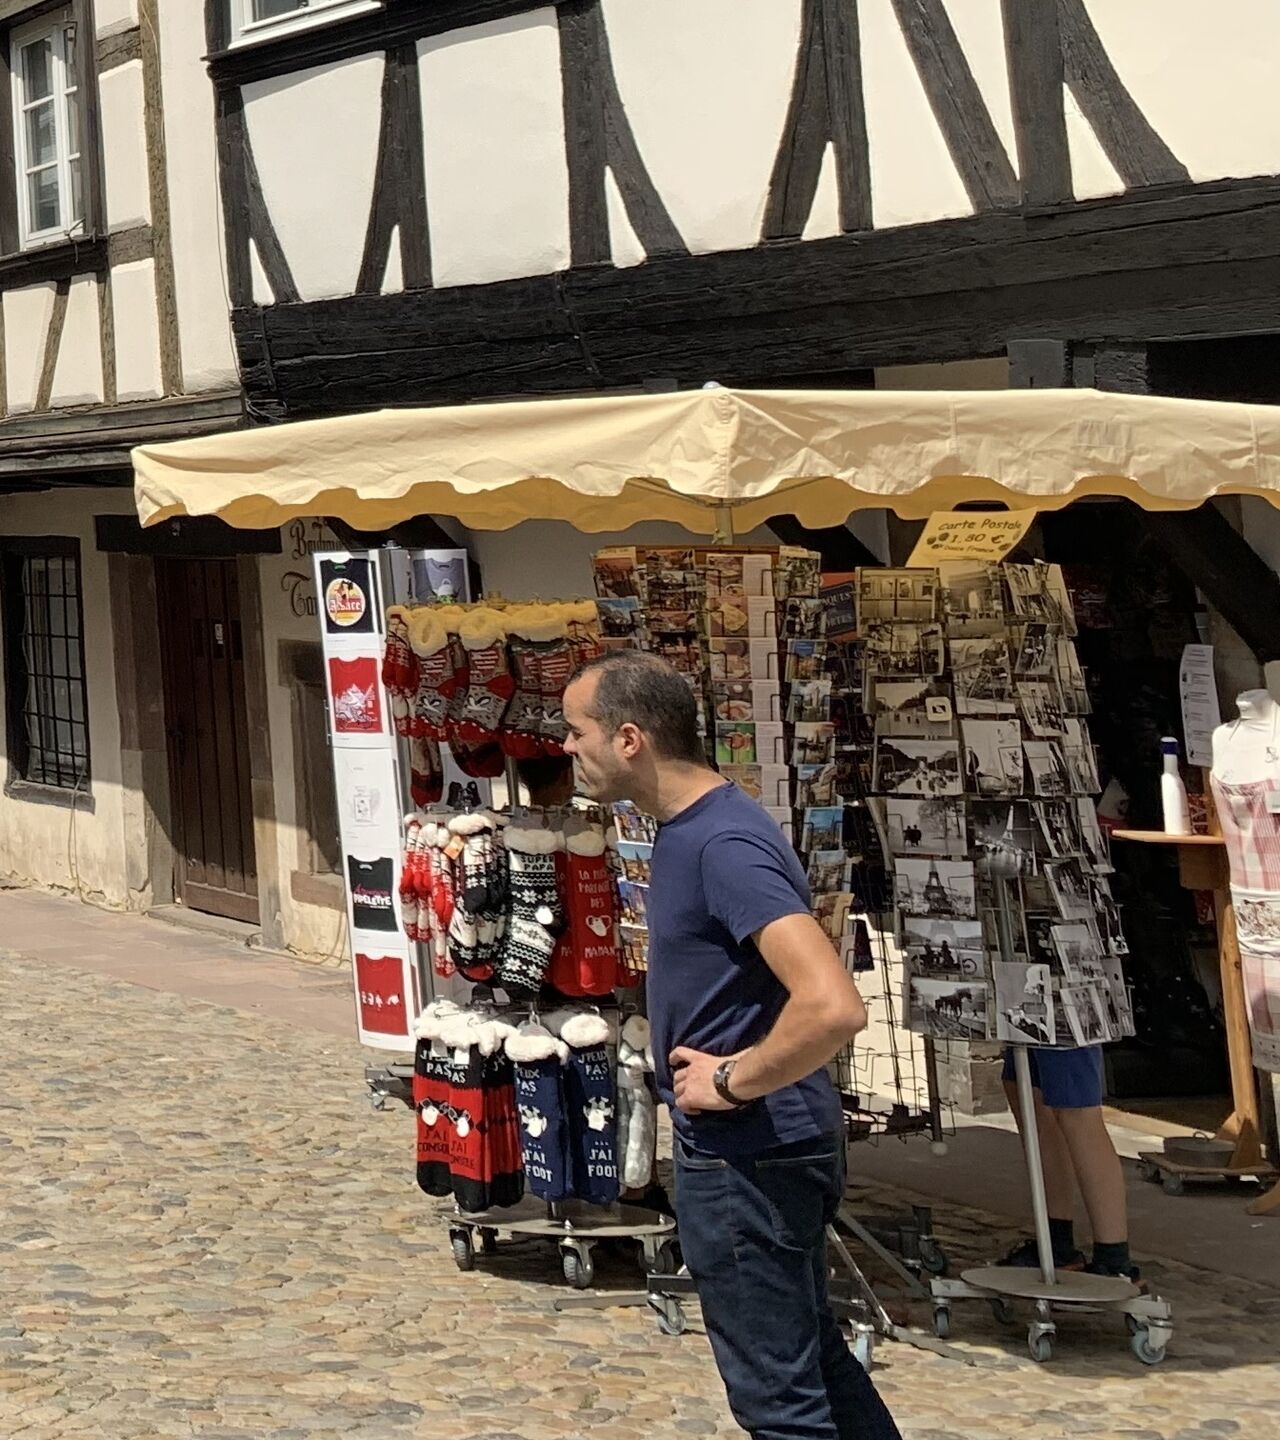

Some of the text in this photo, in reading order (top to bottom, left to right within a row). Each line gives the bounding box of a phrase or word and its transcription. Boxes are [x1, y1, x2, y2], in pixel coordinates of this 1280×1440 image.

[523, 863, 555, 871] PAPA
[426, 1062, 452, 1076] PAS
[585, 1063, 608, 1076] PAS
[525, 1164, 553, 1183] FOOT
[587, 1164, 618, 1178] FOOT
